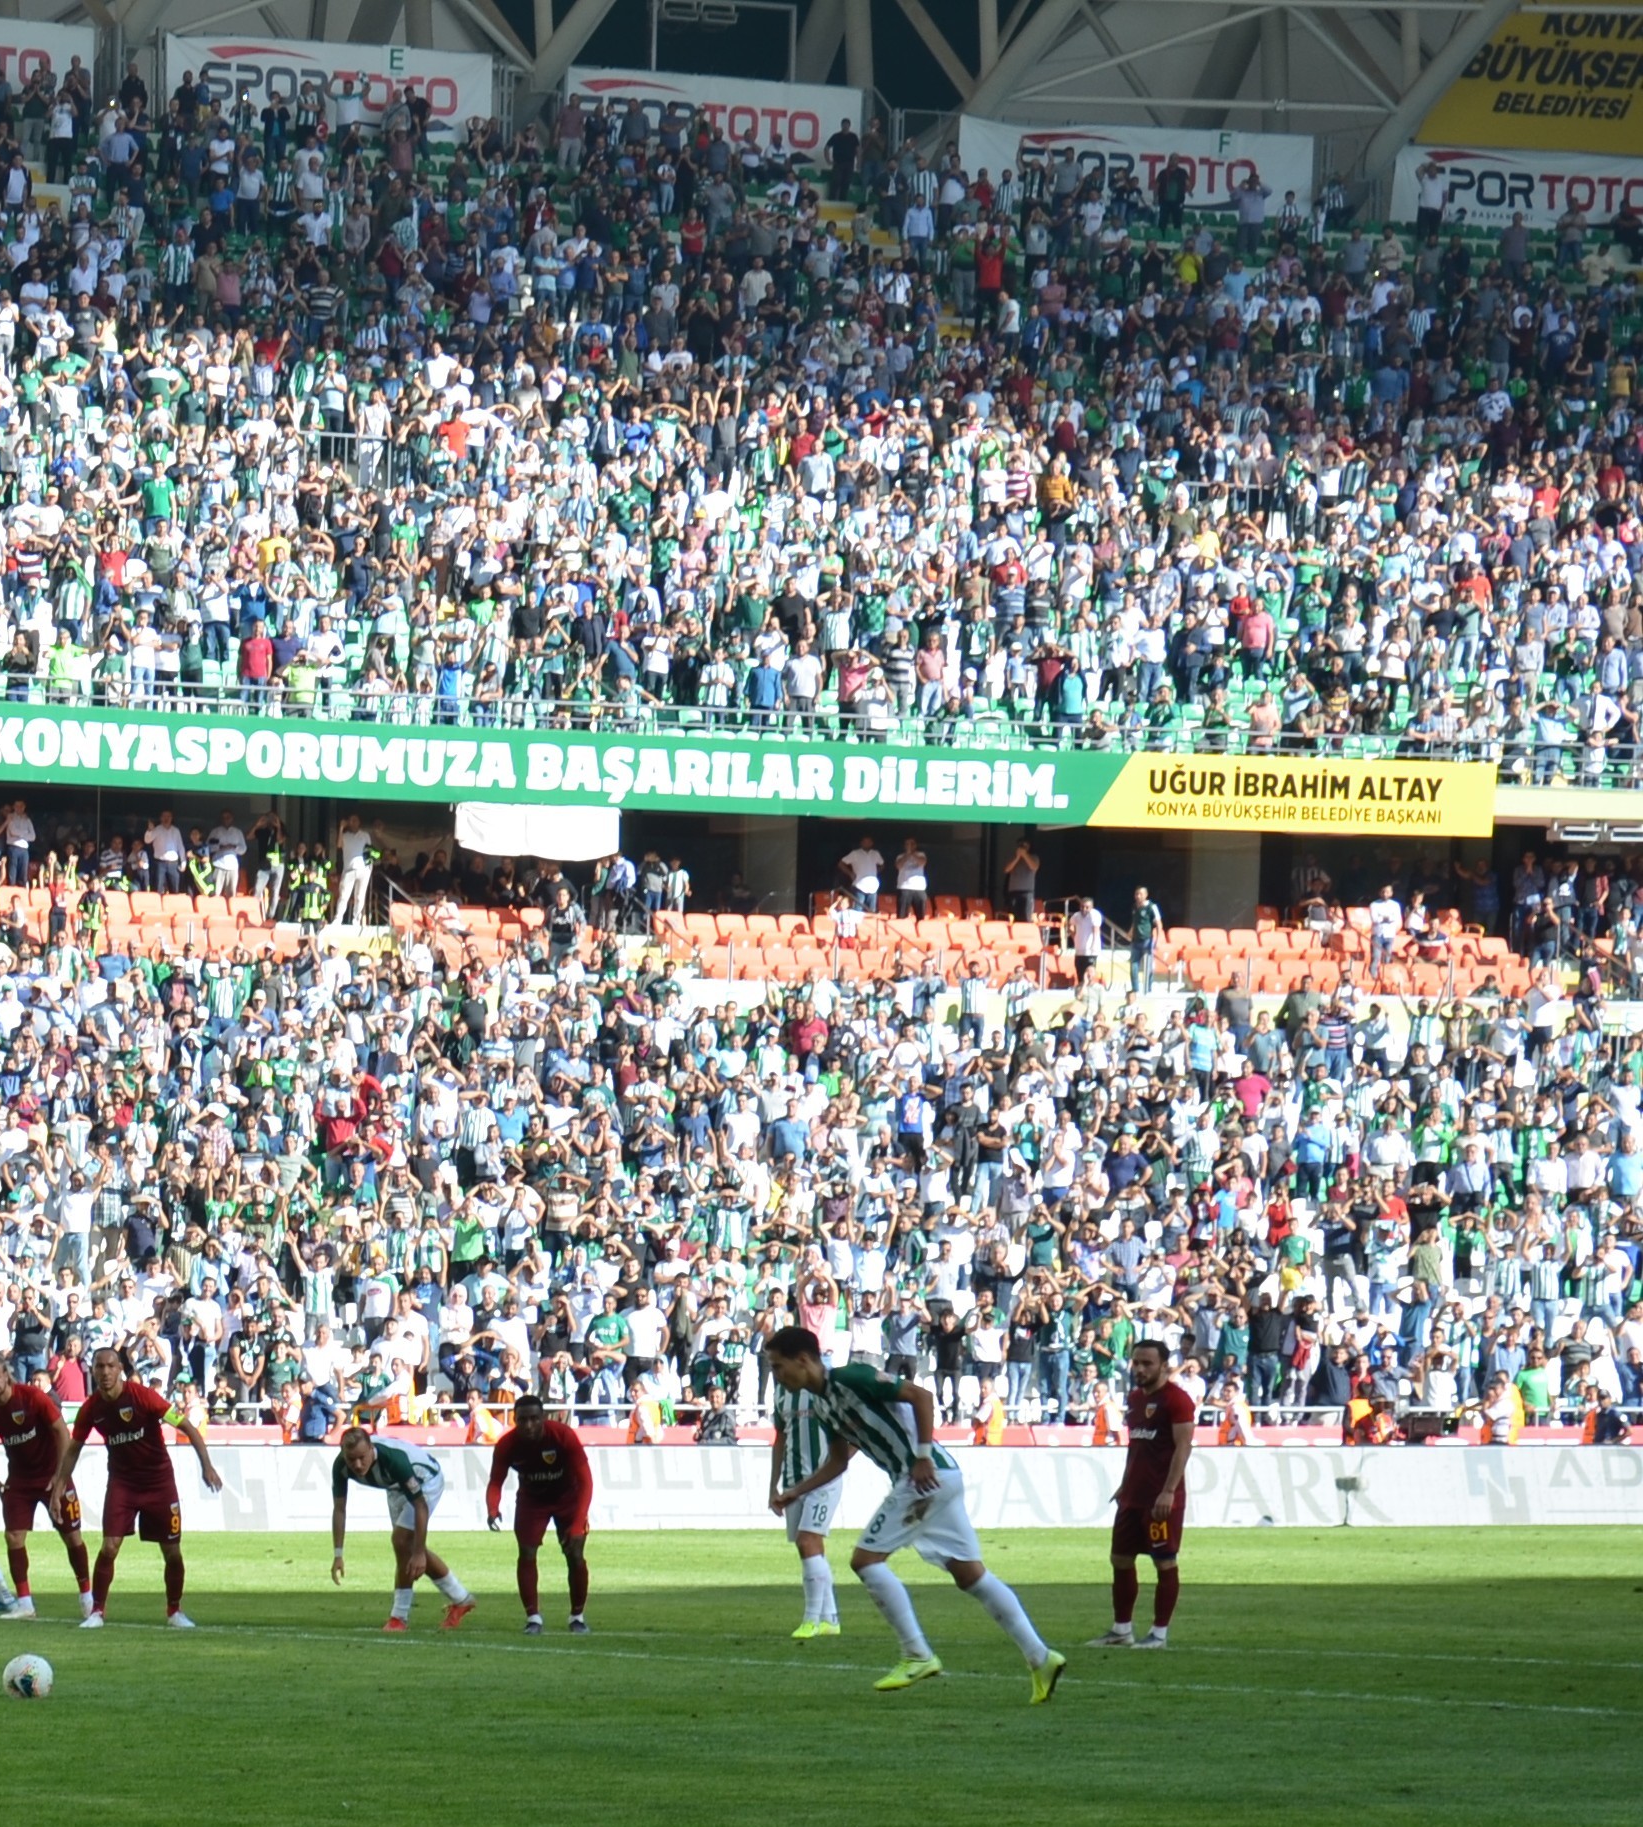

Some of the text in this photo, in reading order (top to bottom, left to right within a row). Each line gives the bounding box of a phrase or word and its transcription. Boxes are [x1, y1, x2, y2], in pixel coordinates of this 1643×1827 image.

[390, 48, 404, 70] E
[1492, 90, 1633, 120] BELEDİYESİ
[1219, 132, 1232, 154] F
[1418, 166, 1643, 216] PORTOTO
[525, 741, 835, 804] BAŞARILAR
[1149, 763, 1444, 803] UĞUR İBRAHİM ALTAY
[1146, 800, 1442, 826] KONYA BÜYÜKŞEHİR BELEDİYE BAŞKANI
[998, 1448, 1395, 1524] ADPARK
[170, 1515, 180, 1534] 9
[811, 1502, 828, 1523] 18
[869, 1512, 886, 1535] 8
[1149, 1521, 1169, 1541] 61
